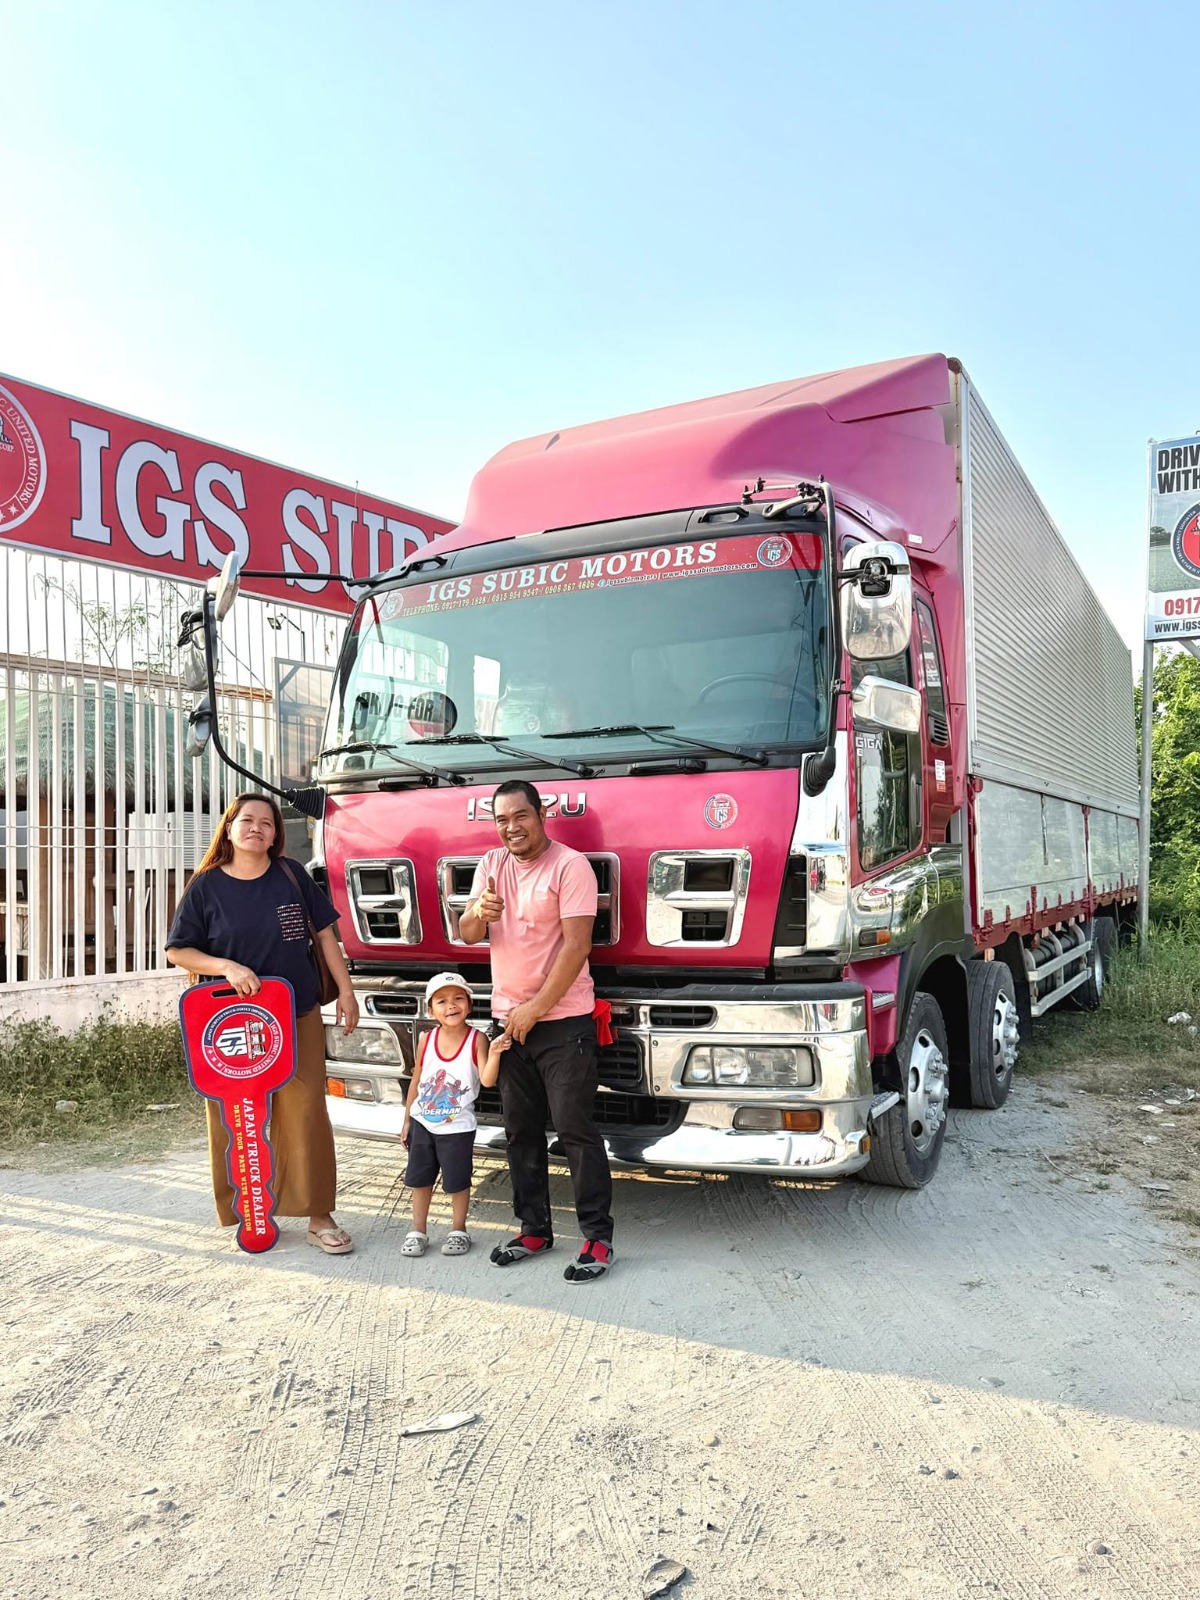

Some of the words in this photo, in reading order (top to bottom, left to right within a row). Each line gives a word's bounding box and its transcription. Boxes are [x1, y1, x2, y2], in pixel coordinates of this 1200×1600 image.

[7, 407, 36, 454] UNITED
[1158, 444, 1200, 471] DRIV
[20, 456, 38, 504] MOTORS
[69, 418, 251, 574] IGS
[280, 487, 444, 602] SU
[427, 577, 473, 603] IGS
[481, 561, 568, 595] SUBIC
[579, 541, 718, 580] MOTORS
[1164, 597, 1200, 616] 0917
[467, 793, 586, 821] ISZU
[215, 1026, 247, 1057] IGS
[242, 1098, 257, 1138] JAPAN
[247, 1141, 261, 1184] TRUCK
[251, 1186, 266, 1236] DEALER
